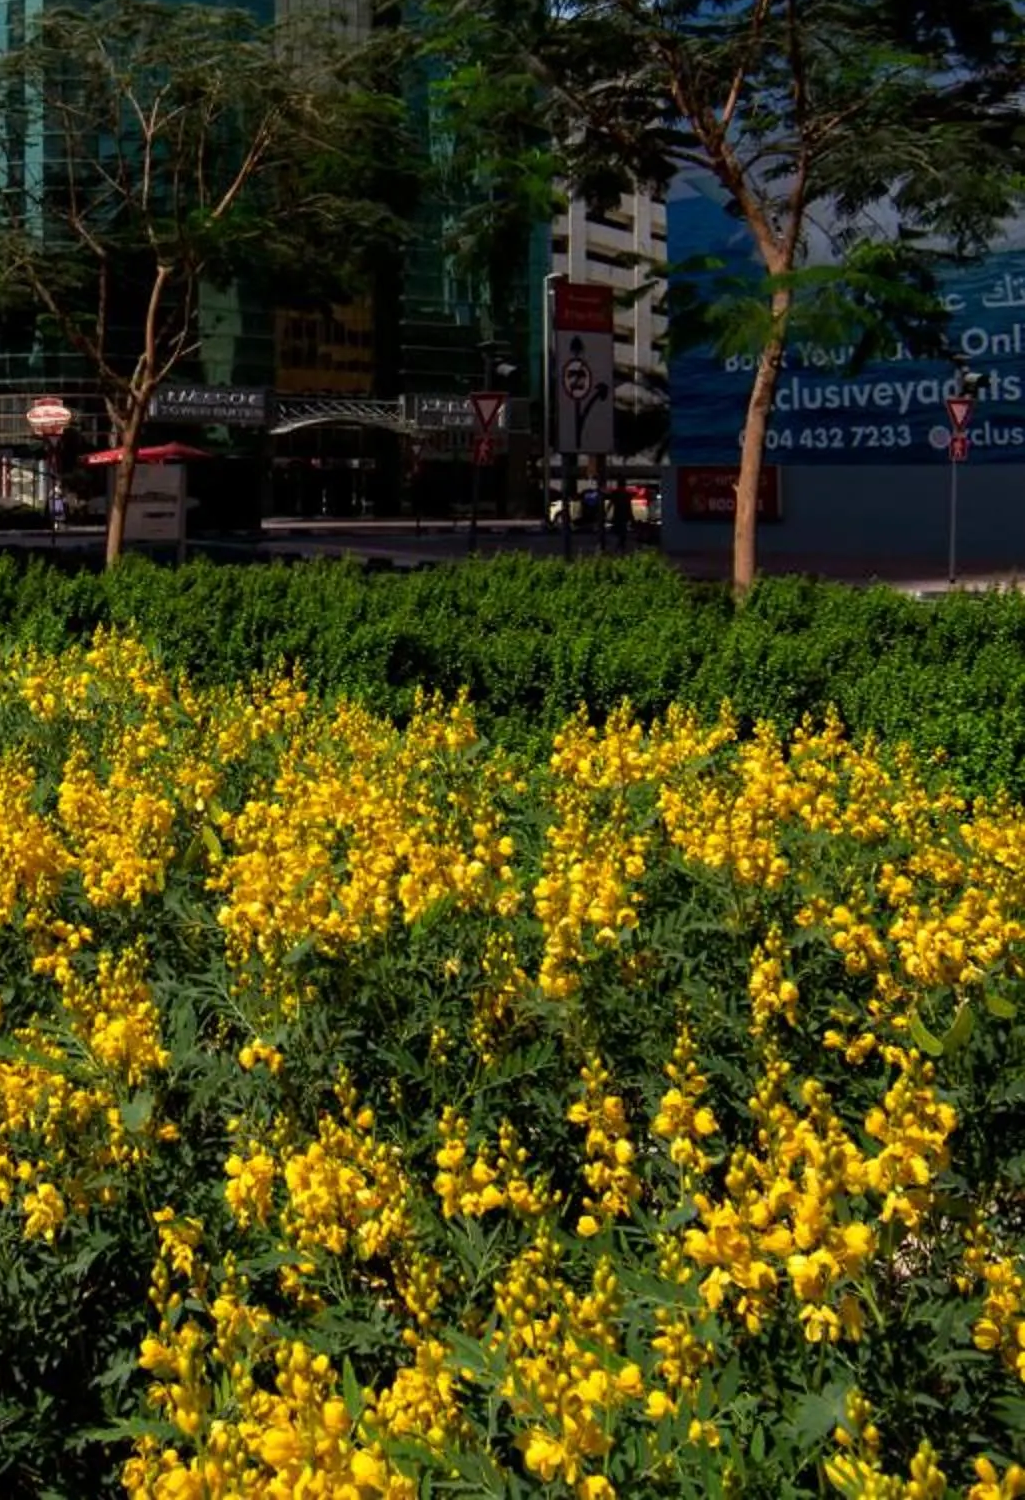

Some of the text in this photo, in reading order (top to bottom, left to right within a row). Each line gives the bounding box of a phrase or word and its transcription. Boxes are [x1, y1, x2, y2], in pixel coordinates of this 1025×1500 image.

[961, 323, 1025, 356] Onl
[799, 427, 844, 449] 432
[850, 424, 913, 447] 7233
